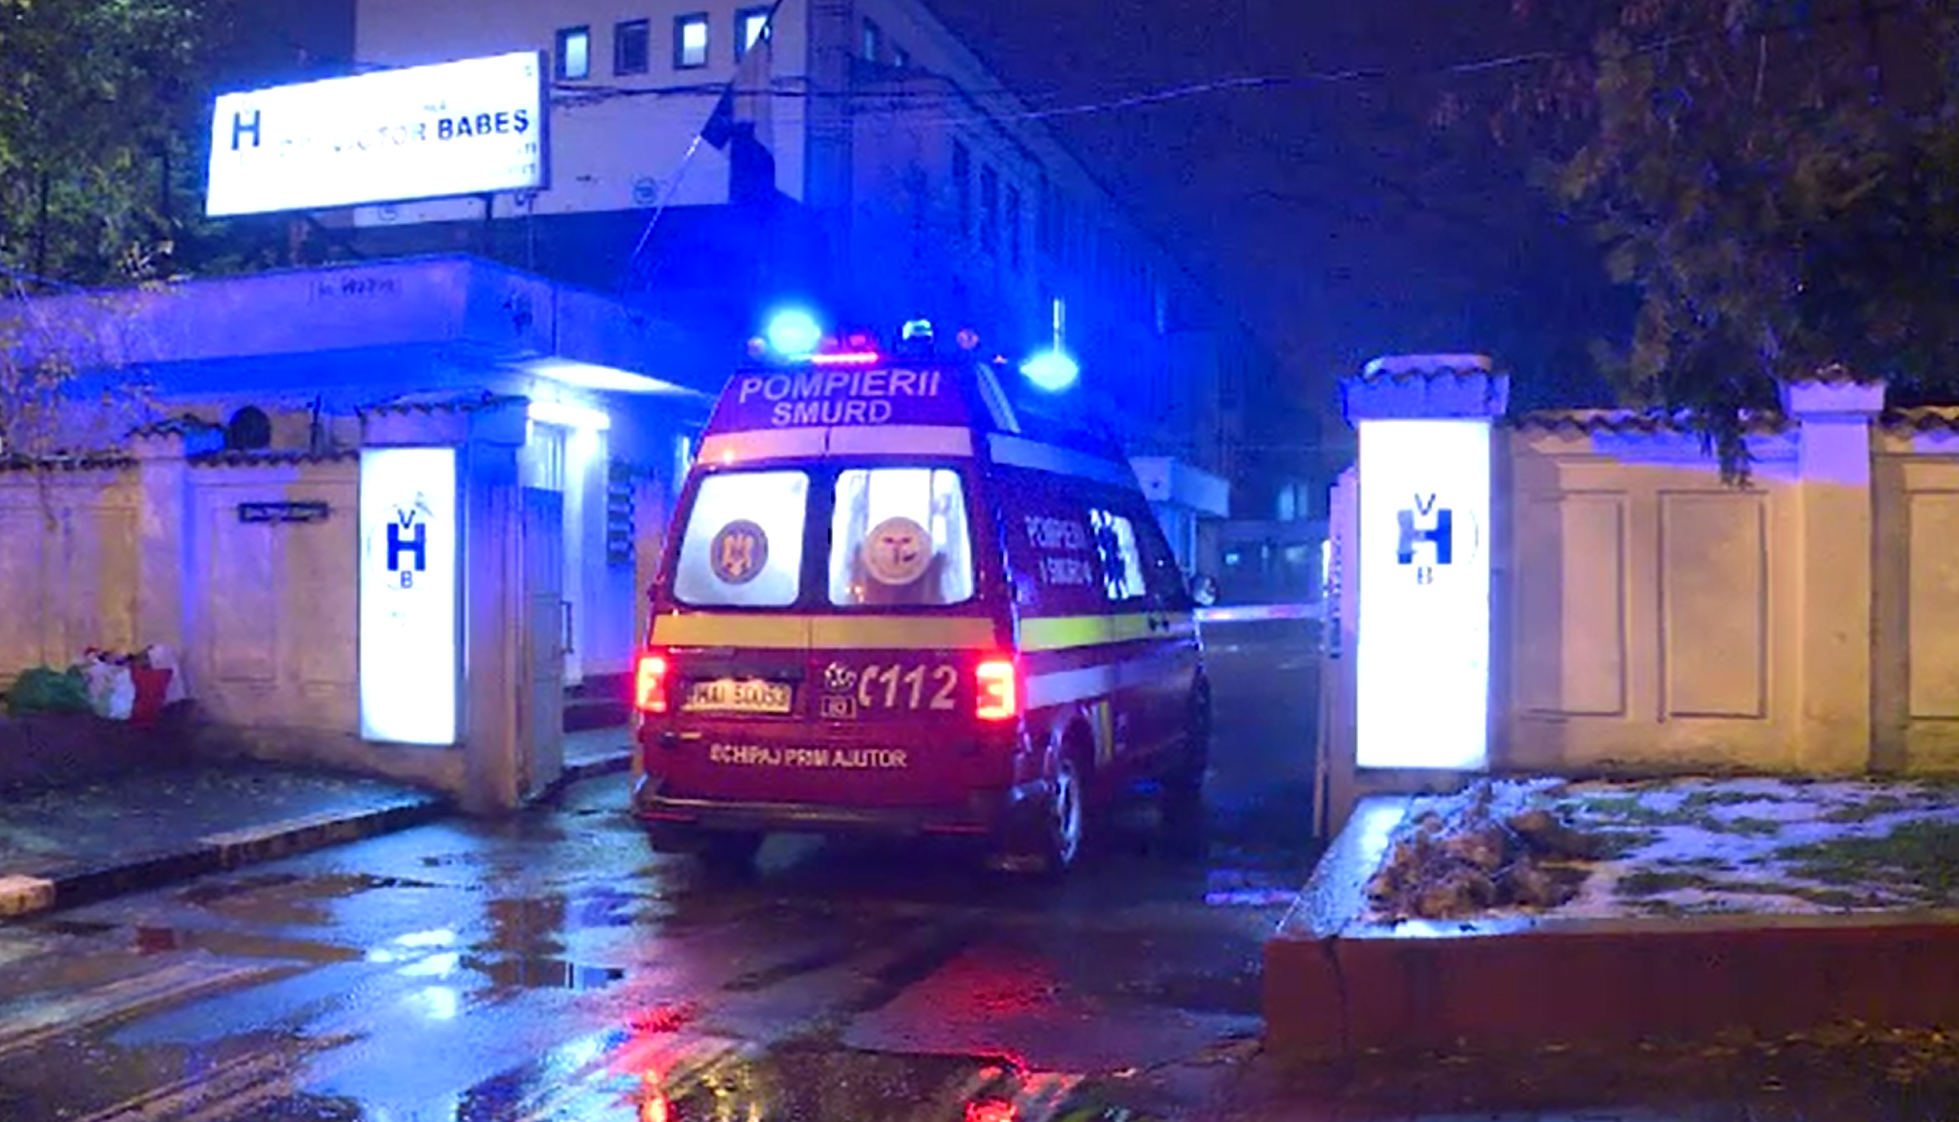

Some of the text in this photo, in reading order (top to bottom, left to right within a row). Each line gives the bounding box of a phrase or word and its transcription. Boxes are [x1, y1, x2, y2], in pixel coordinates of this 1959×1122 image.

[231, 109, 261, 151] H
[739, 370, 940, 404] POMPIERII
[771, 399, 892, 427] SMURD
[1414, 492, 1436, 517] V
[386, 522, 426, 572] H
[1397, 508, 1452, 565] H
[400, 570, 414, 589] B
[832, 748, 908, 769] AJUTOR
